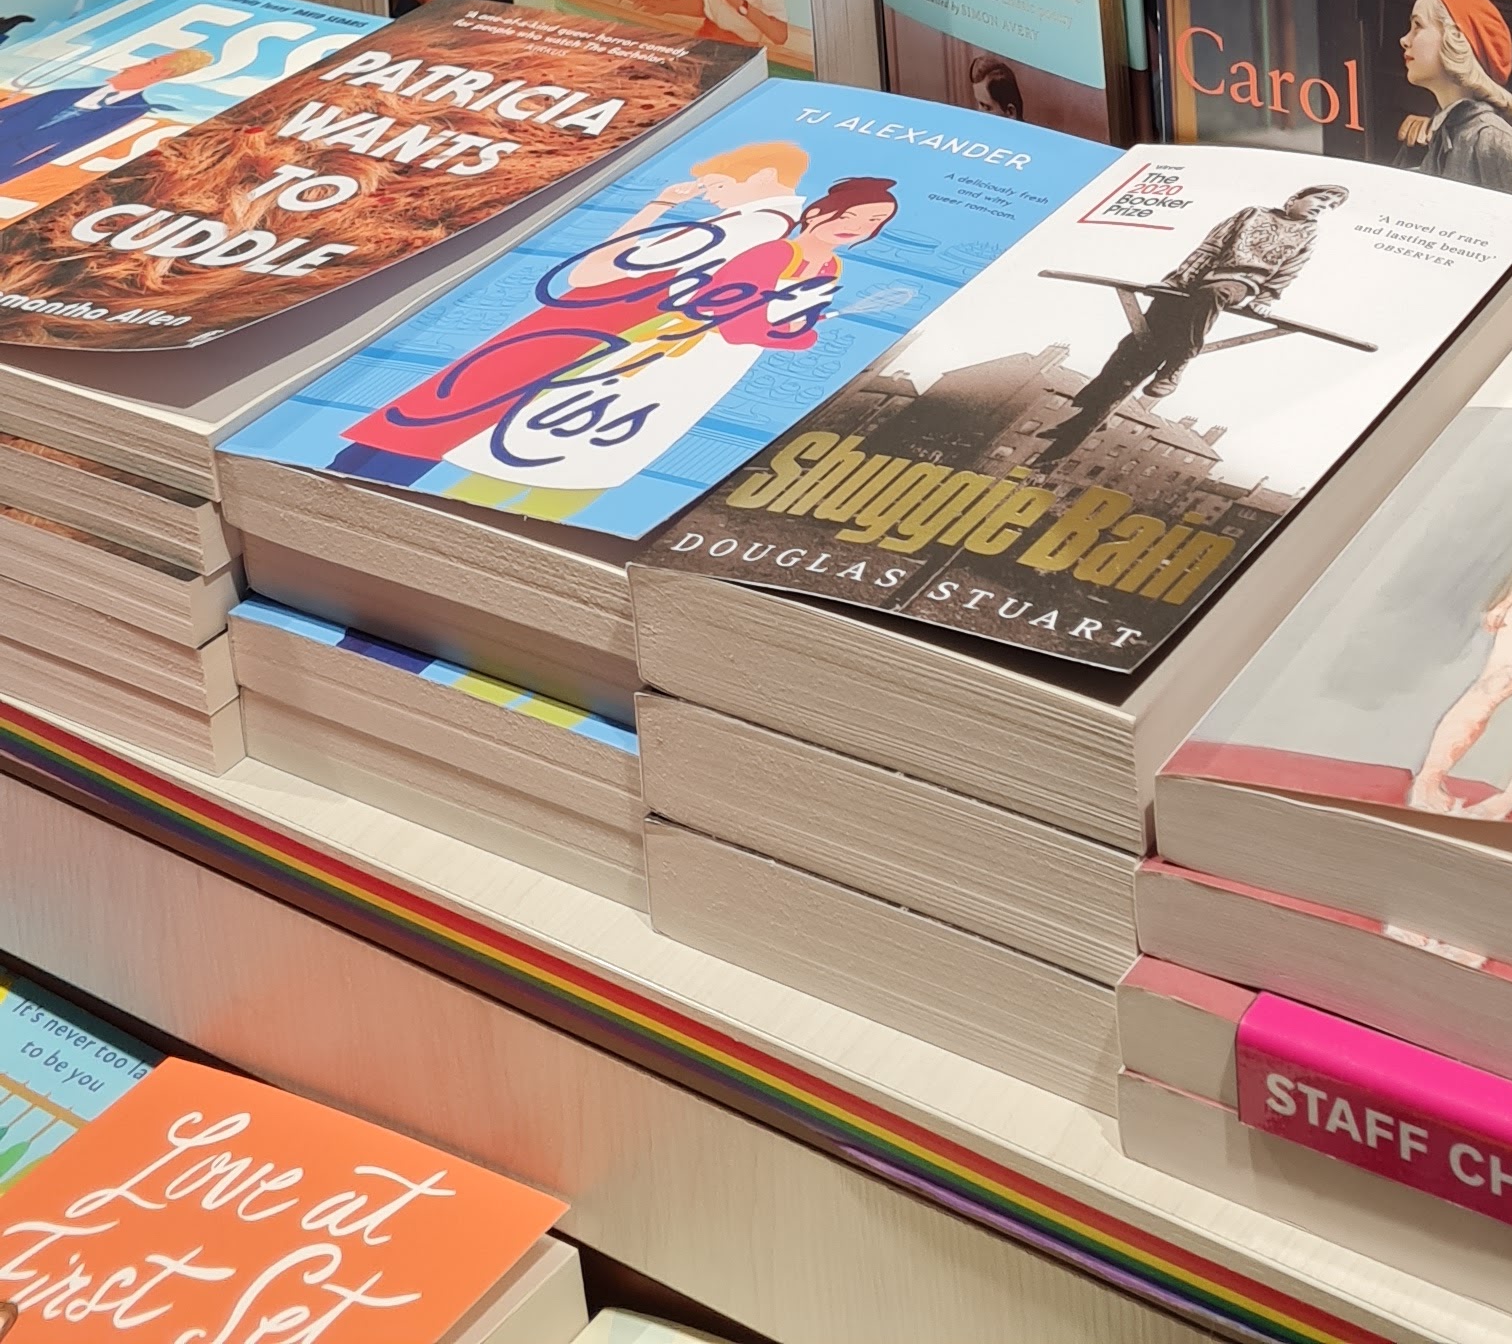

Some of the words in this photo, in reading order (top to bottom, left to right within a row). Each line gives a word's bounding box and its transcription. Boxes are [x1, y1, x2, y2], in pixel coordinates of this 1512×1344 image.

[320, 50, 626, 138] PATRICIA
[1174, 24, 1367, 133] Carol
[277, 102, 522, 177] WANTS
[795, 106, 829, 131] TJ
[835, 114, 1032, 172] ALEXANDER
[248, 164, 364, 212] TO
[1102, 204, 1154, 218] Prize
[1114, 193, 1194, 210] Booker
[1126, 183, 1184, 196] 2020
[70, 202, 359, 279] CUDDLE
[535, 209, 842, 342] Chef's
[1373, 241, 1455, 268] OBSERVER
[385, 329, 660, 467] Kiss
[726, 430, 1056, 559] Shuggie
[1014, 484, 1246, 609] Bain
[669, 531, 907, 591] DOUGLAS
[926, 581, 1146, 649] STUART
[20, 1041, 43, 1058] to
[43, 1049, 69, 1073] be
[62, 1067, 105, 1093] you
[1265, 1071, 1429, 1162] STAFF
[65, 1111, 304, 1221] Love
[301, 1164, 456, 1245] at
[1, 1216, 236, 1328] First
